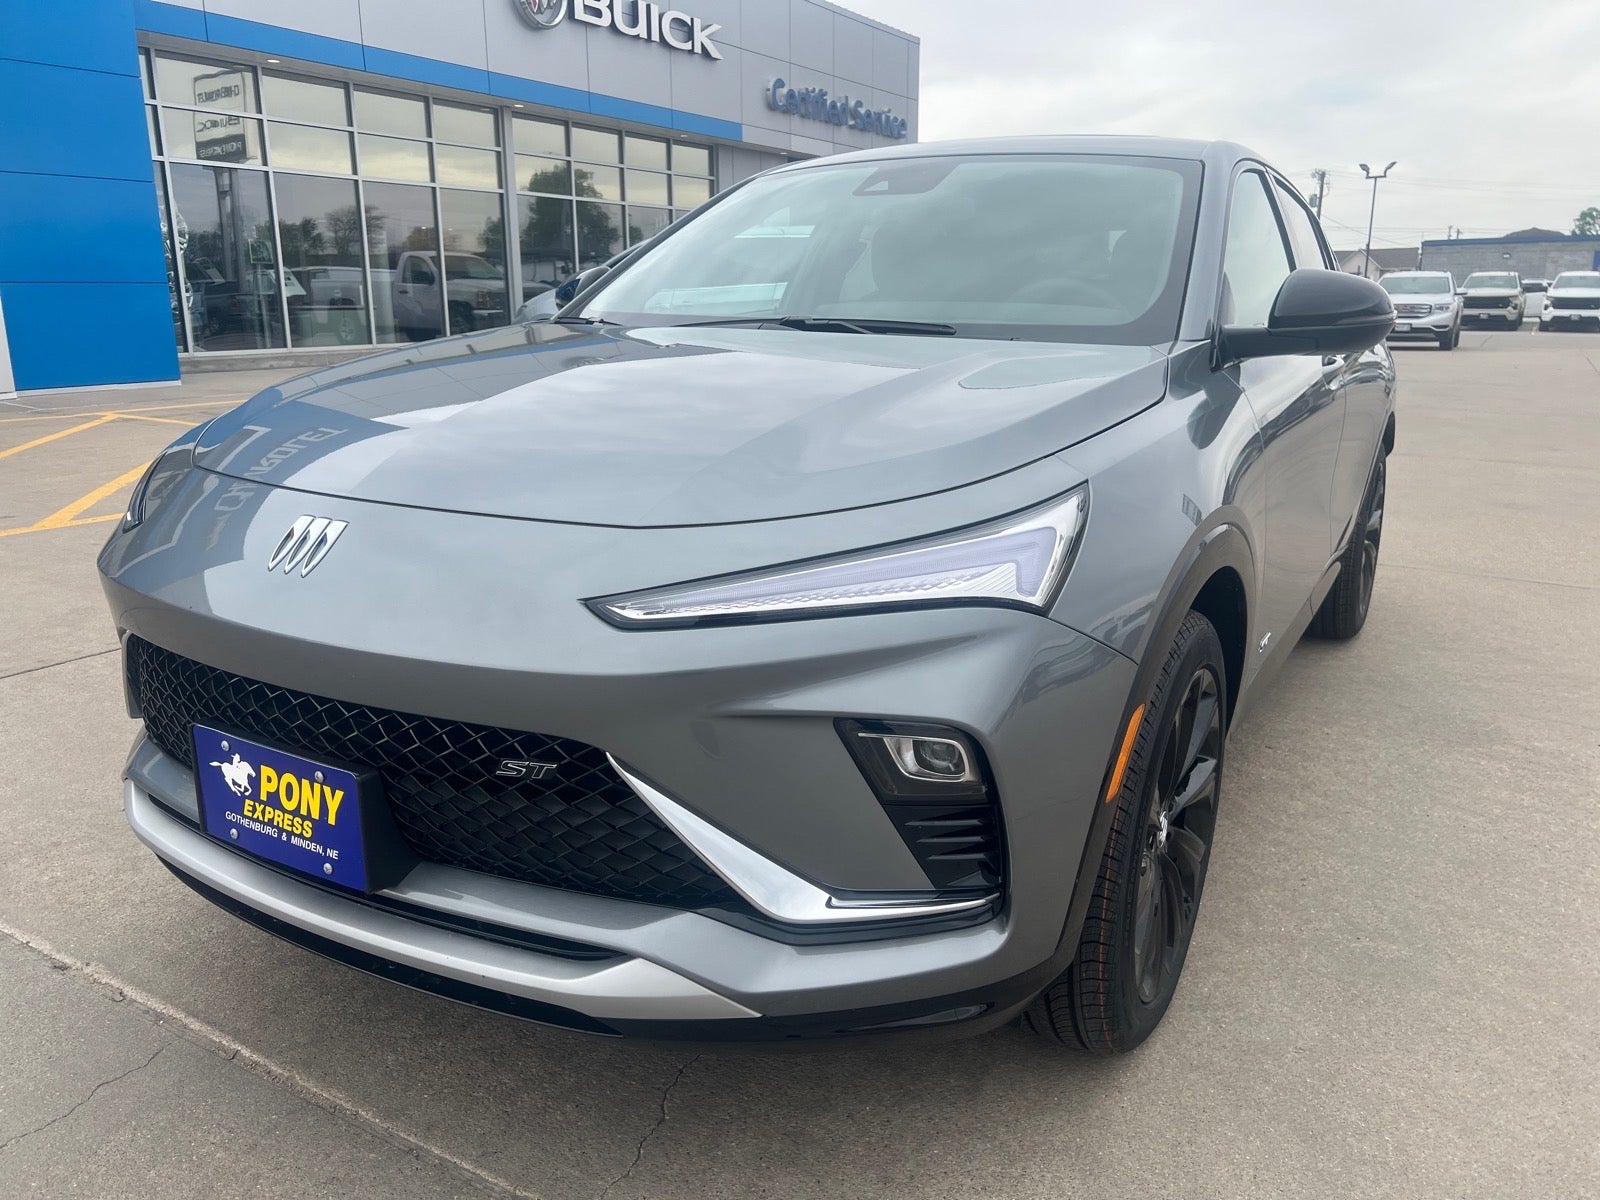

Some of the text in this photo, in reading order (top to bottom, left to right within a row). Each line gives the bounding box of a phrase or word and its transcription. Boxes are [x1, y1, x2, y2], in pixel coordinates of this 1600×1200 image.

[769, 78, 908, 139] Certified Service
[495, 760, 558, 779] ST
[243, 799, 313, 838] EXPRESS
[259, 764, 345, 826] PONY
[225, 811, 339, 860] GOTHENBURG & MINDEN, NE
